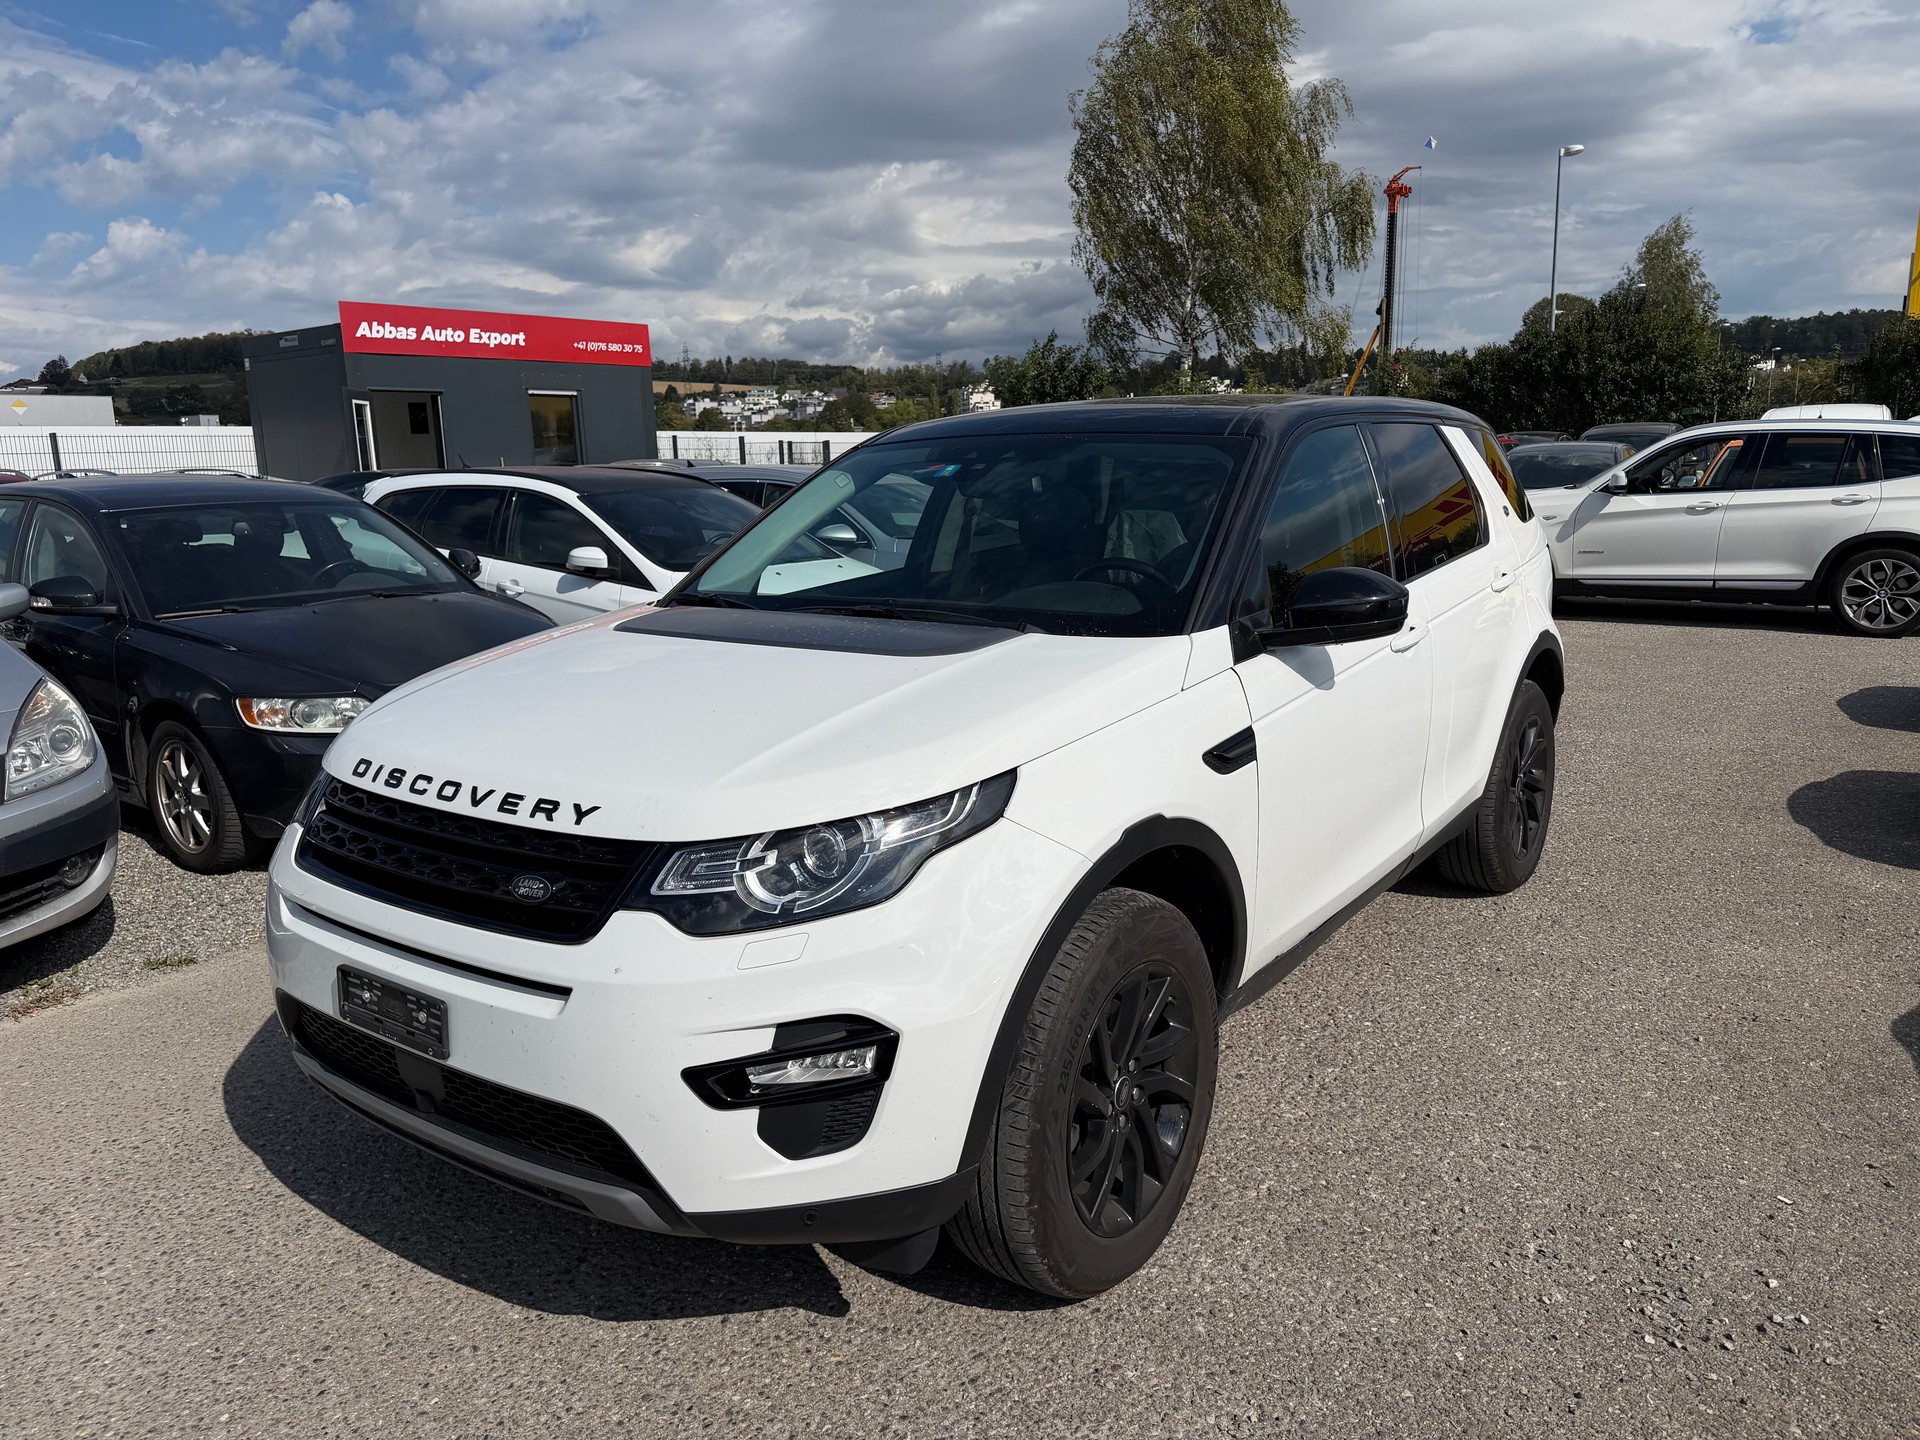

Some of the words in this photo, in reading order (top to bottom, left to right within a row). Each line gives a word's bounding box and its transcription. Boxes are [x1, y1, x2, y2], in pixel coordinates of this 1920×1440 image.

[355, 321, 417, 340] Abbas
[420, 325, 465, 343] Auto
[468, 328, 526, 347] Export
[573, 341, 586, 350] +41
[587, 341, 607, 352] (0)76
[607, 342, 622, 352] 580
[623, 343, 633, 353] 30
[633, 344, 643, 353] 75
[352, 757, 602, 826] DISCOVERY
[517, 886, 544, 898] ROVER
[518, 878, 540, 888] LAND
[1057, 1023, 1084, 1095] 235/60
